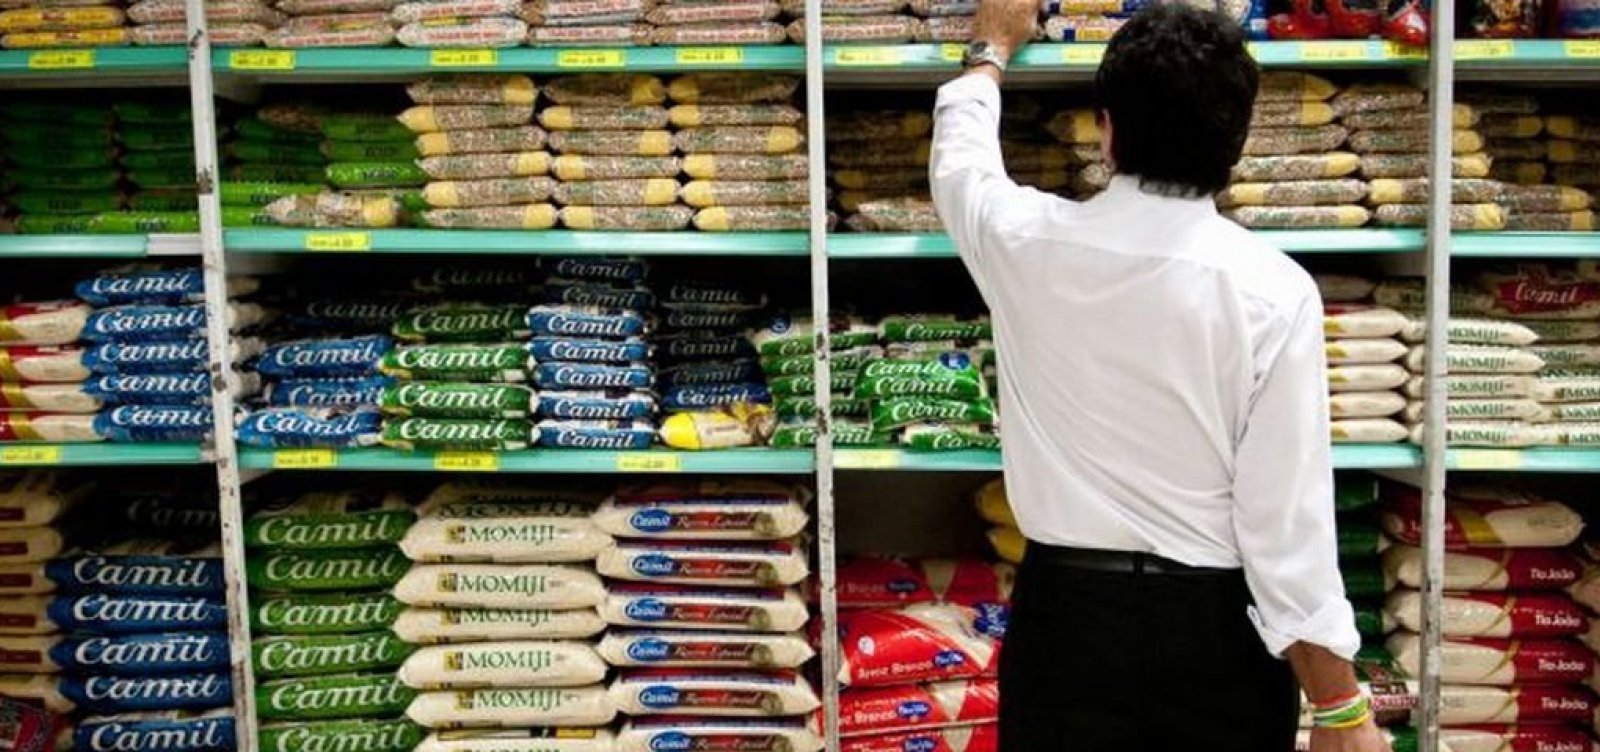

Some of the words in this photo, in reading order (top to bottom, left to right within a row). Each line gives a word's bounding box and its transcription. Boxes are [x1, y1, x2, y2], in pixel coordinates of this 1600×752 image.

[92, 273, 190, 294] Camil
[95, 308, 203, 333] Camil
[412, 311, 512, 333] Camil
[548, 313, 624, 334] Camil
[100, 340, 208, 362] Camil
[275, 342, 378, 367] Camil
[397, 347, 515, 368] Camil
[551, 341, 626, 360] Camil
[99, 373, 208, 393] Camil
[554, 366, 633, 385] Camil
[876, 376, 958, 395] Camil
[401, 384, 506, 408] Camil
[554, 399, 631, 418] Camil
[893, 402, 970, 421] Camil
[256, 411, 360, 435] Camil
[402, 418, 512, 440] Camil
[557, 429, 635, 448] Camil
[259, 514, 398, 545] Camil
[632, 515, 671, 528] Camil
[469, 525, 555, 545] MOMIJI
[74, 557, 209, 585] Camil
[265, 553, 399, 580] Camil
[460, 575, 547, 597] MOMIJI
[73, 595, 209, 621] Camil
[259, 599, 393, 627] Camil
[75, 636, 213, 664] Camil
[260, 636, 393, 671] Camil
[466, 651, 551, 672] MOMIJI
[85, 674, 219, 700] Camil
[271, 681, 406, 711] Camil
[477, 690, 561, 711] MOMIJI
[91, 721, 222, 752] Camil
[276, 723, 412, 752] Camil
